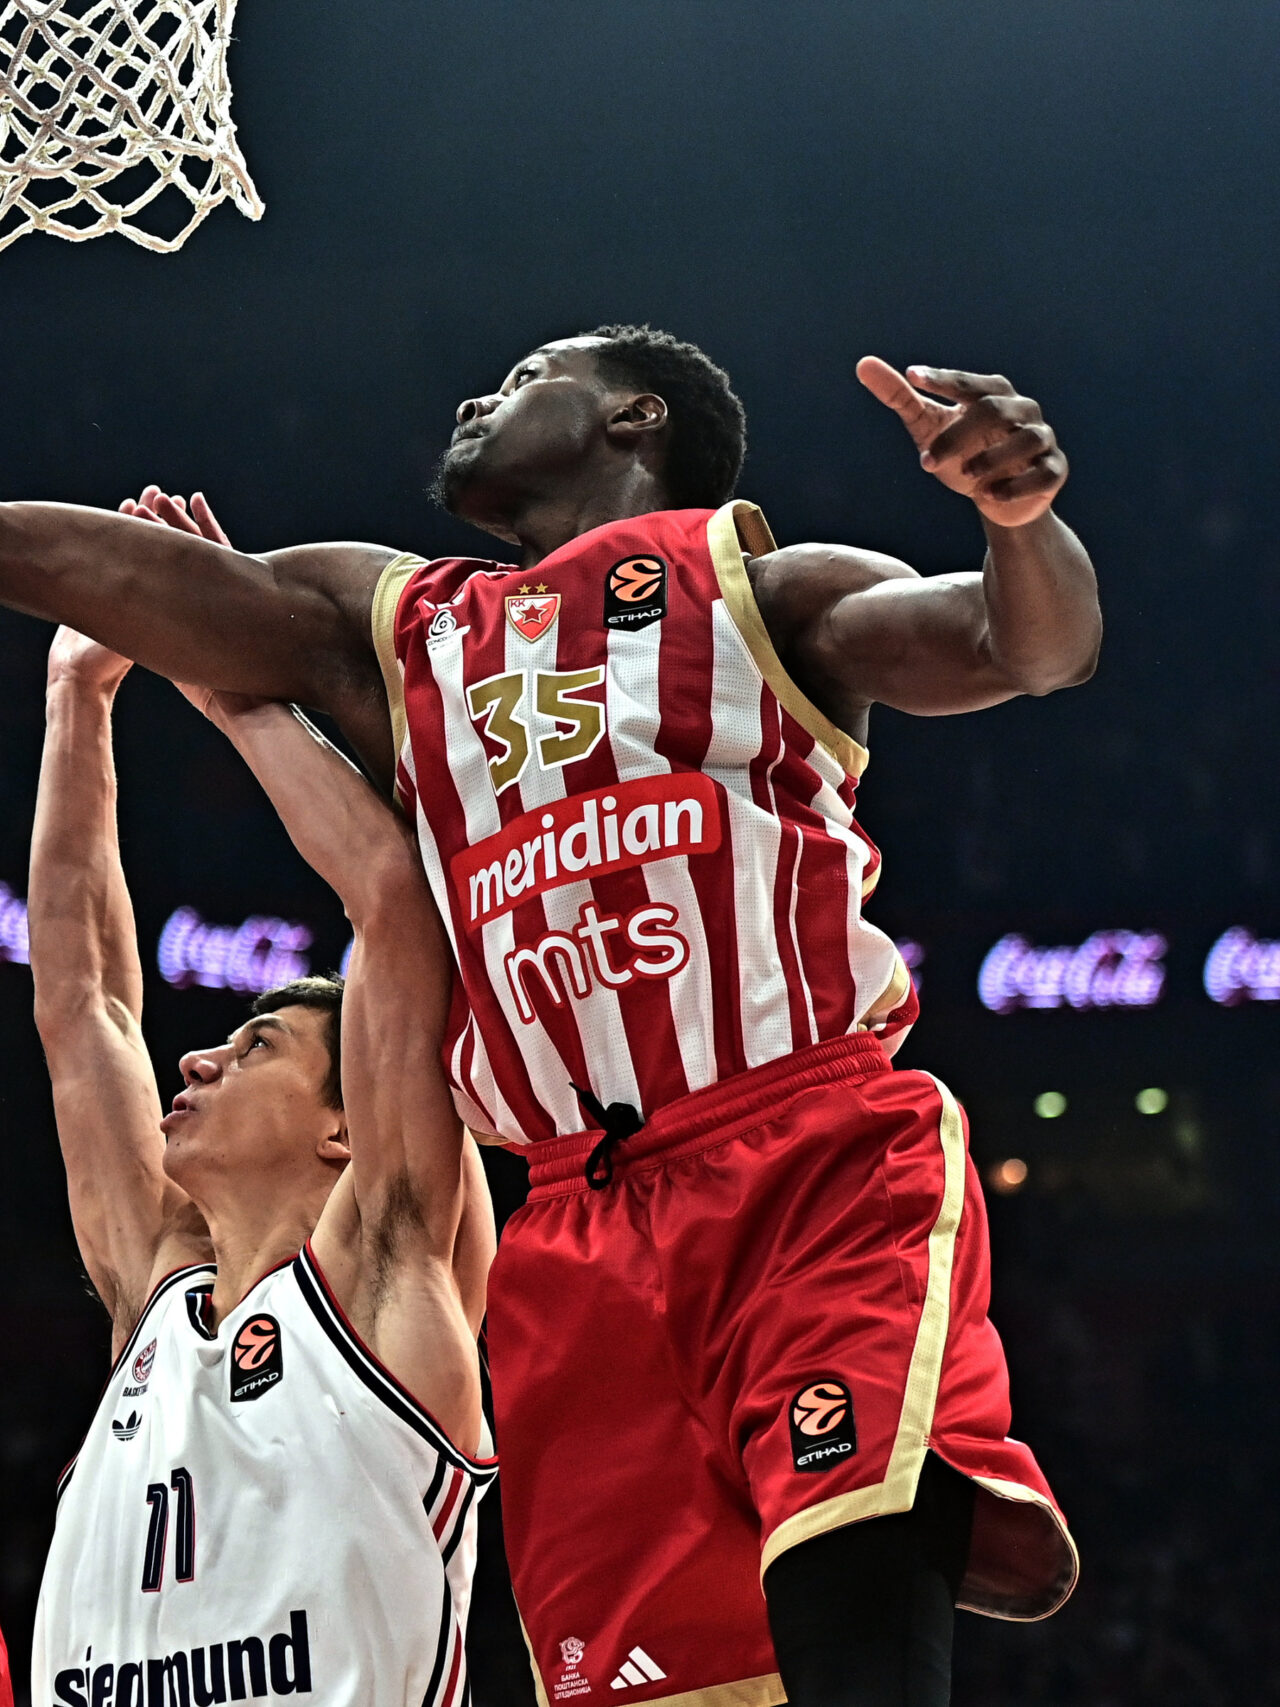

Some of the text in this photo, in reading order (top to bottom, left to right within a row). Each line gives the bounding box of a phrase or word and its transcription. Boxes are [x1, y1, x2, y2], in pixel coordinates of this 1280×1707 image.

[607, 608, 663, 624] ETIHAD
[466, 664, 605, 796] 35
[469, 796, 703, 922] meridian
[506, 905, 687, 1019] mts
[234, 1372, 279, 1397] ETIHAD
[797, 1442, 852, 1466] ETIHAD
[141, 1467, 196, 1593] 11
